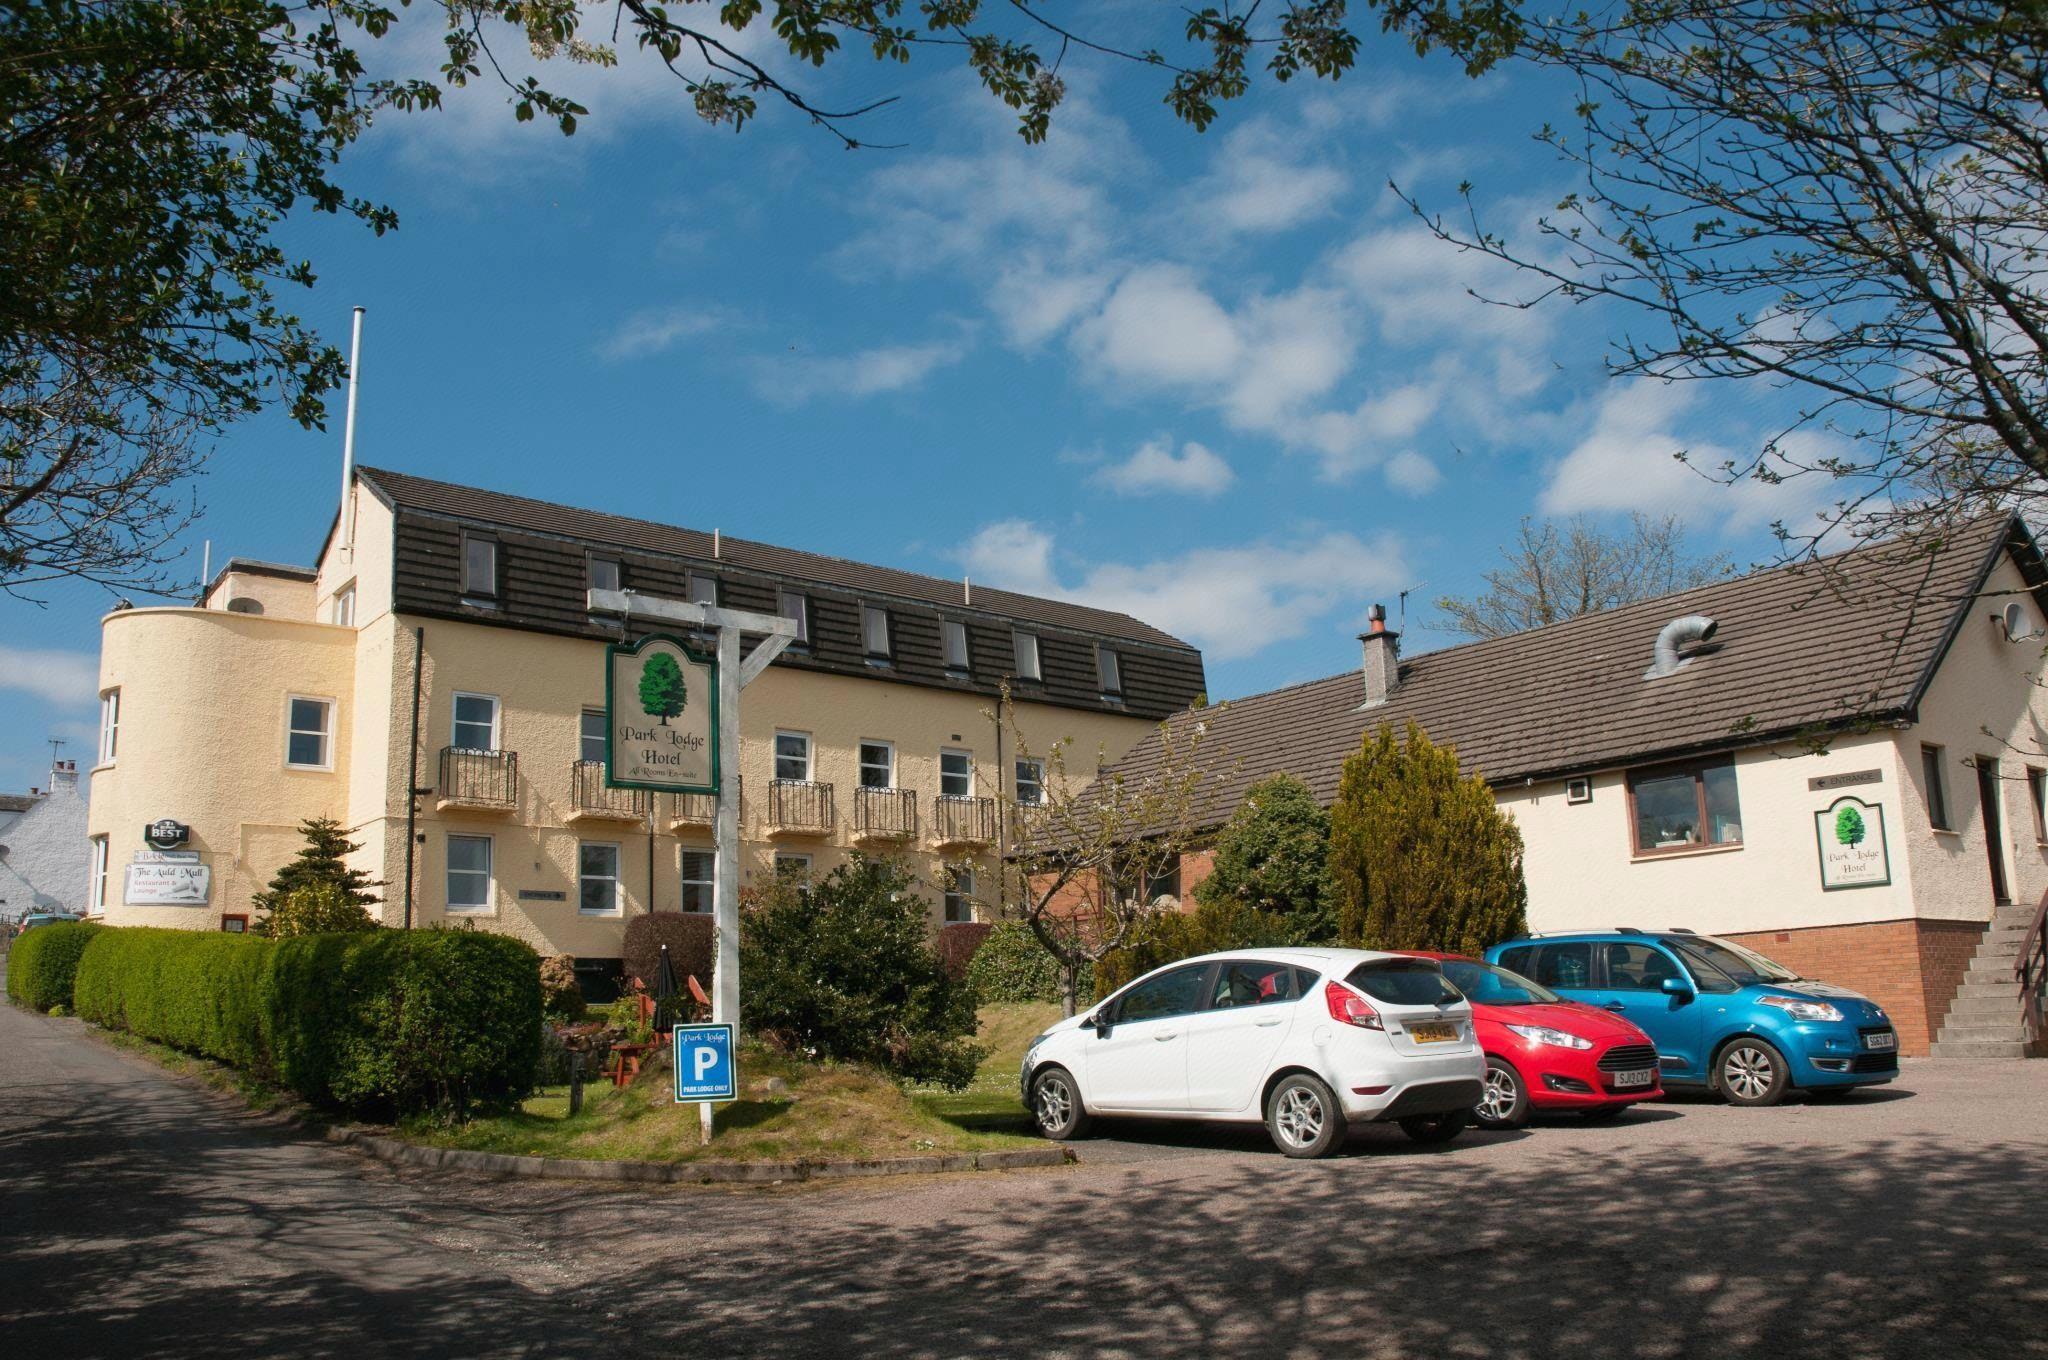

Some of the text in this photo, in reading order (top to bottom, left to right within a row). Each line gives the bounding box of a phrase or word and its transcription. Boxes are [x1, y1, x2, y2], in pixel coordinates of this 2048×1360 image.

[620, 726, 704, 751] Park Lodge
[641, 749, 681, 765] Hotel
[641, 767, 665, 778] Rooms
[1830, 772, 1874, 785] ENTRANCE
[151, 829, 183, 838] BEST
[1829, 849, 1879, 862] Park Lodge
[135, 867, 204, 878] The Auld Mull
[1842, 863, 1866, 873] Hotel
[682, 1032, 726, 1045] Park Lodge
[694, 1046, 719, 1081] P
[1620, 1072, 1636, 1084] SJ13
